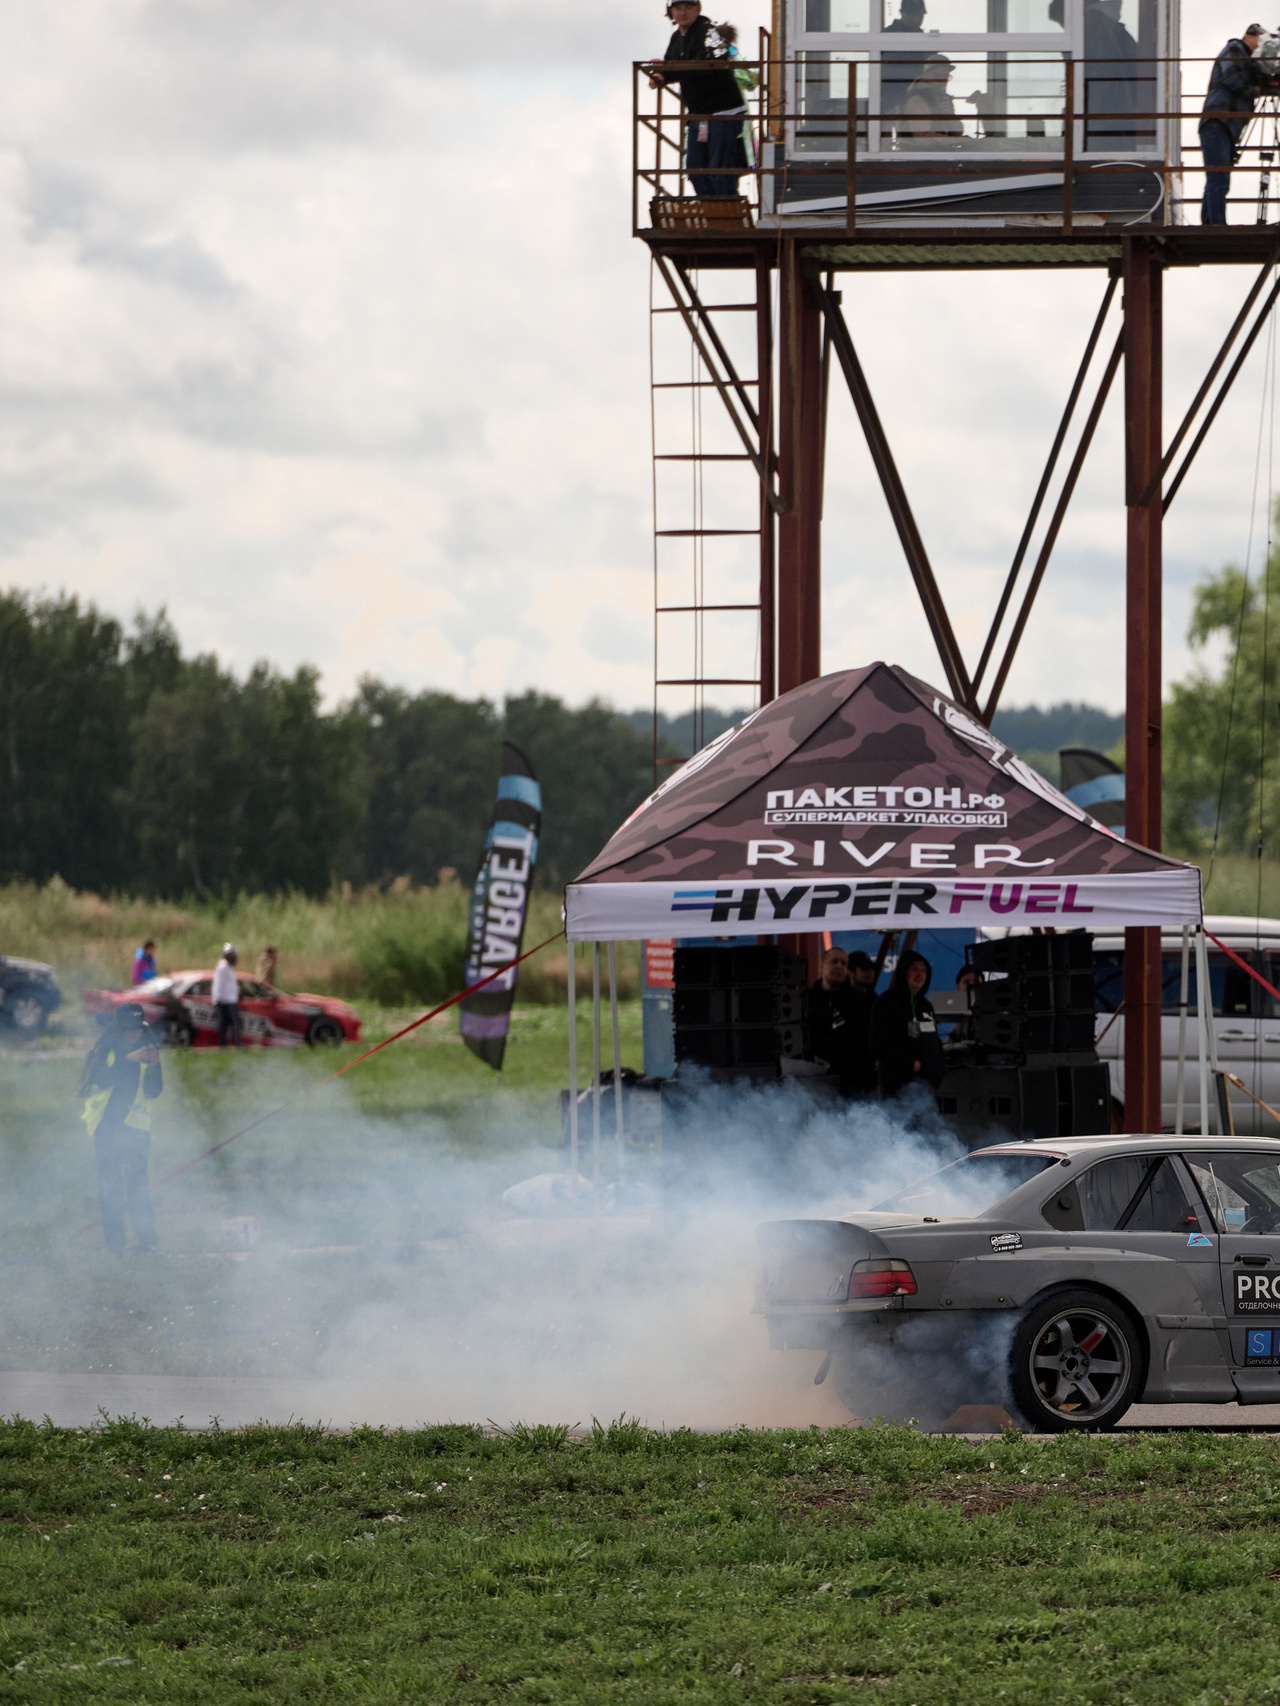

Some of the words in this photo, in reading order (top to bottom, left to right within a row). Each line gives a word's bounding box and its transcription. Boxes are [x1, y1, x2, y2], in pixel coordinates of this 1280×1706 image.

[772, 811, 898, 823] СУПЕРМАРКЕТ
[903, 812, 1001, 825] УПАКОВКИ
[747, 839, 1055, 869] RIVER
[1246, 1357, 1272, 1365] Service
[1273, 1357, 1280, 1365] &
